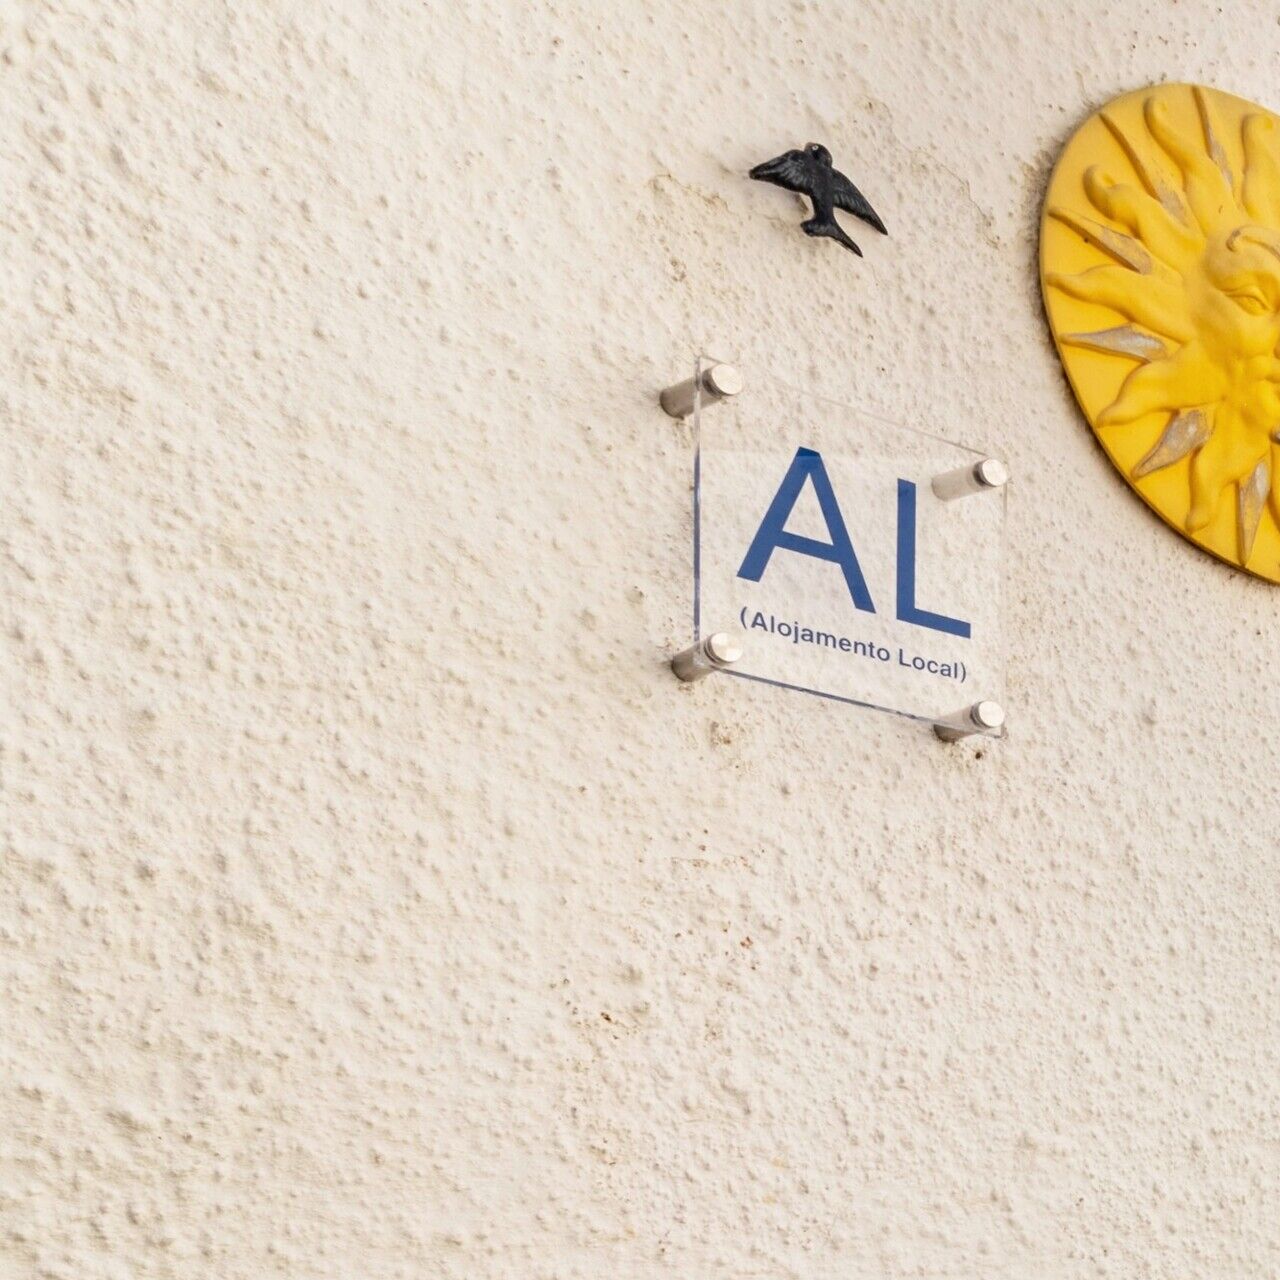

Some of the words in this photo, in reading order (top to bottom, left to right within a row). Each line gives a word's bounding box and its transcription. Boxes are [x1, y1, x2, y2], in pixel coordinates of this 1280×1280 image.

[737, 446, 971, 639] AL
[740, 606, 891, 662] (Alojamento
[899, 647, 968, 683] Local)
